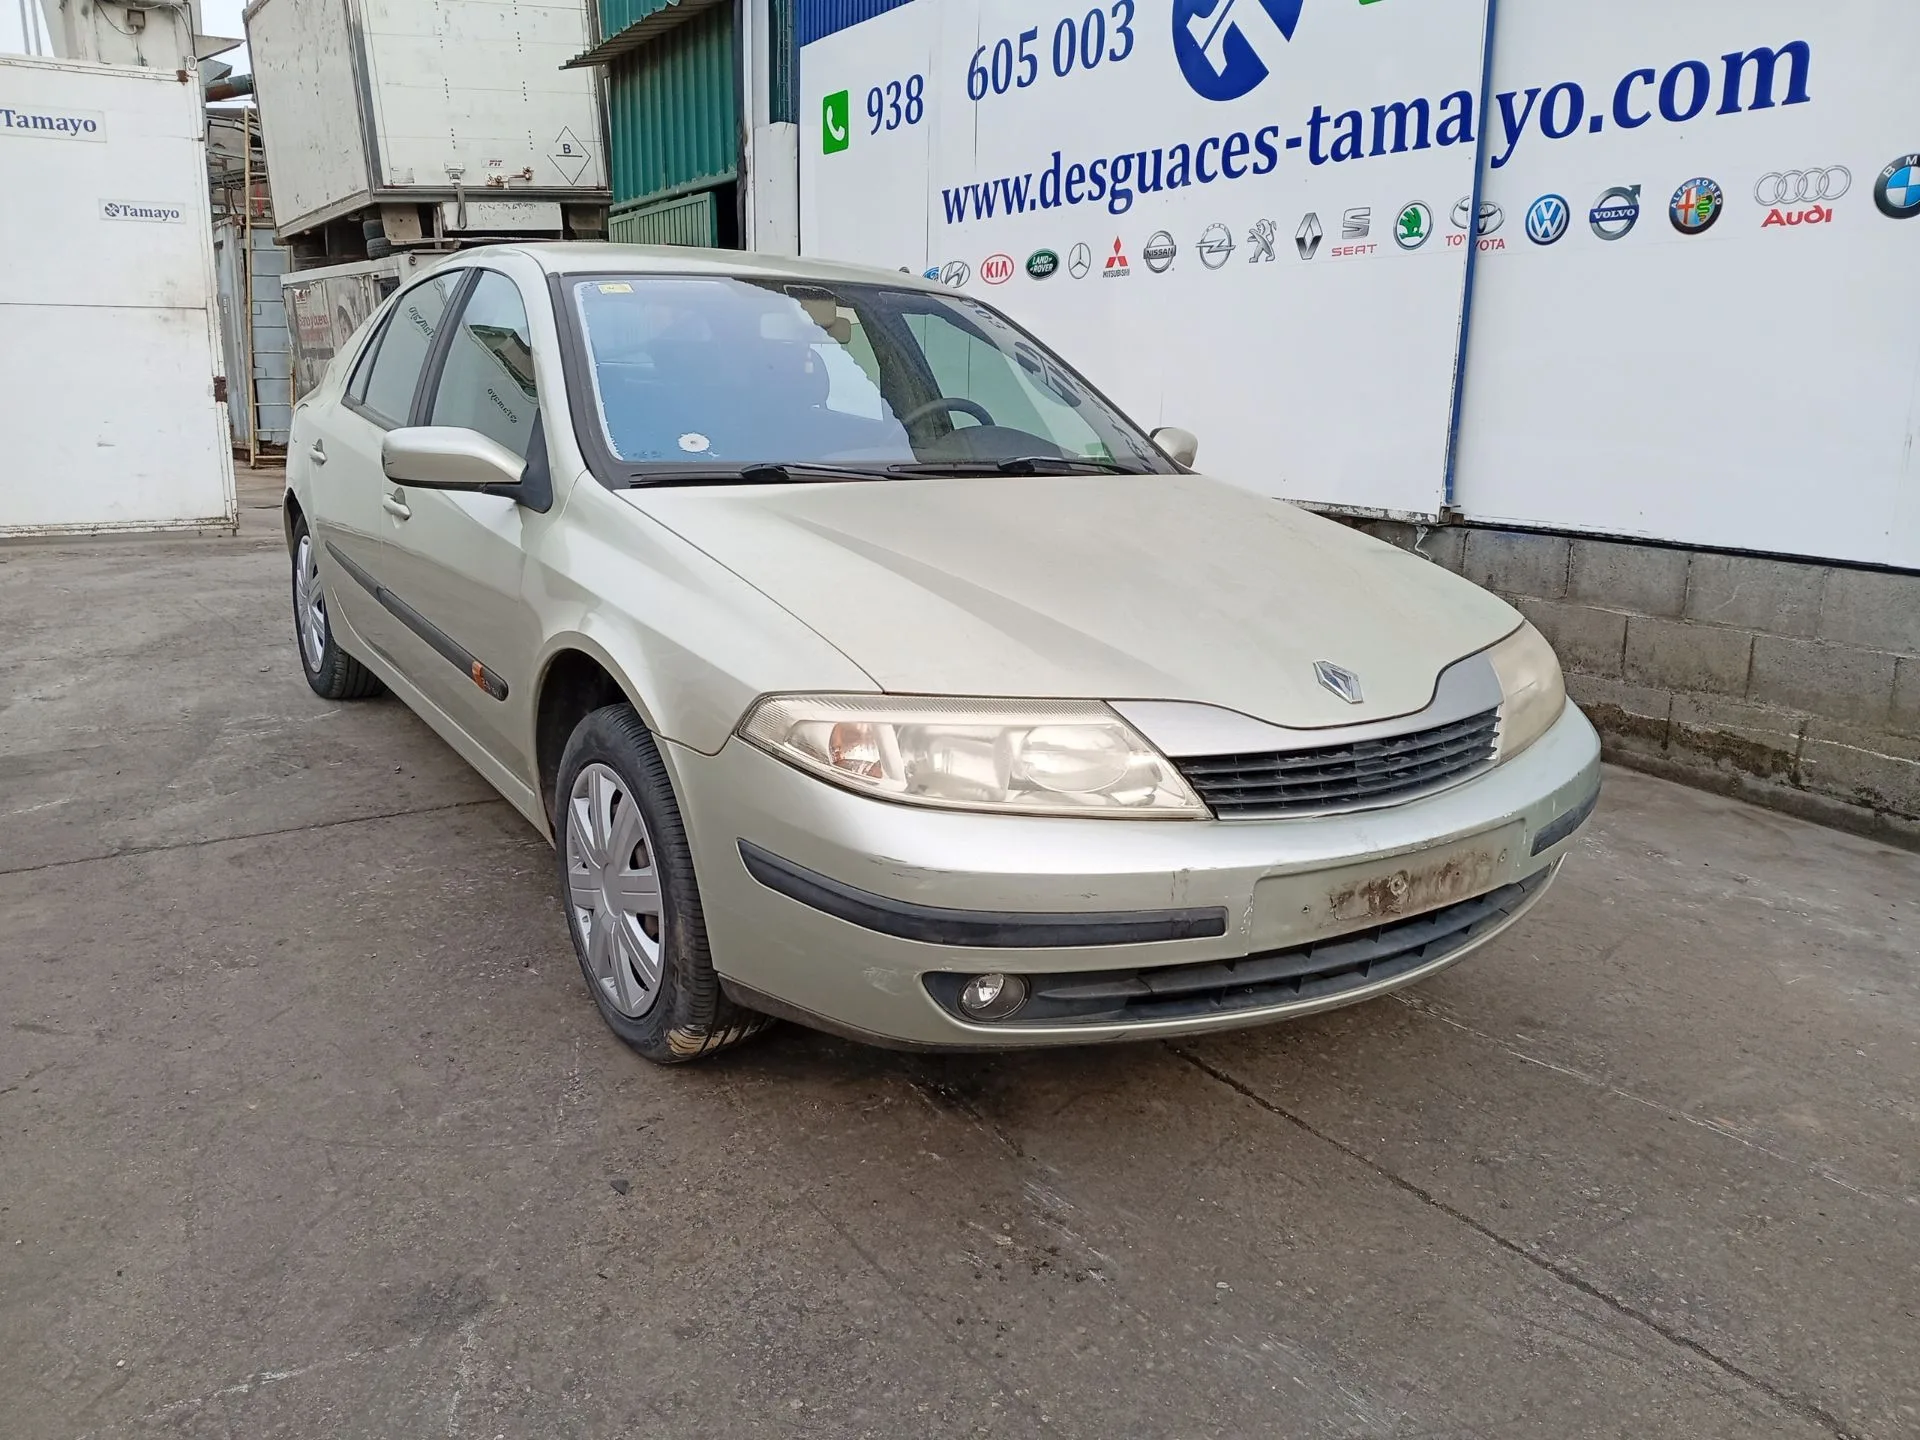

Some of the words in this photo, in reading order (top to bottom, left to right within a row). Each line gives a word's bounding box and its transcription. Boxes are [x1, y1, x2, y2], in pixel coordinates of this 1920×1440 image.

[867, 74, 924, 135] 938
[967, 26, 1038, 101] 605
[1053, 0, 1134, 77] 003
[0, 109, 97, 136] Tamayo
[942, 40, 1811, 224] www.desguaces-tamayo.com
[562, 143, 572, 154] B
[1671, 185, 1688, 209] ALFA
[1695, 179, 1722, 205] ROMEO
[120, 205, 180, 221] Tamayo
[1593, 208, 1636, 219] VOLVO
[1761, 204, 1833, 229] Audi
[1146, 248, 1174, 258] NISSAN
[1331, 244, 1379, 258] SEAT
[1032, 255, 1049, 265] LAND
[986, 260, 1009, 279] KIA
[1033, 263, 1054, 273] ROVER
[1102, 268, 1131, 279] MITSUBISHI
